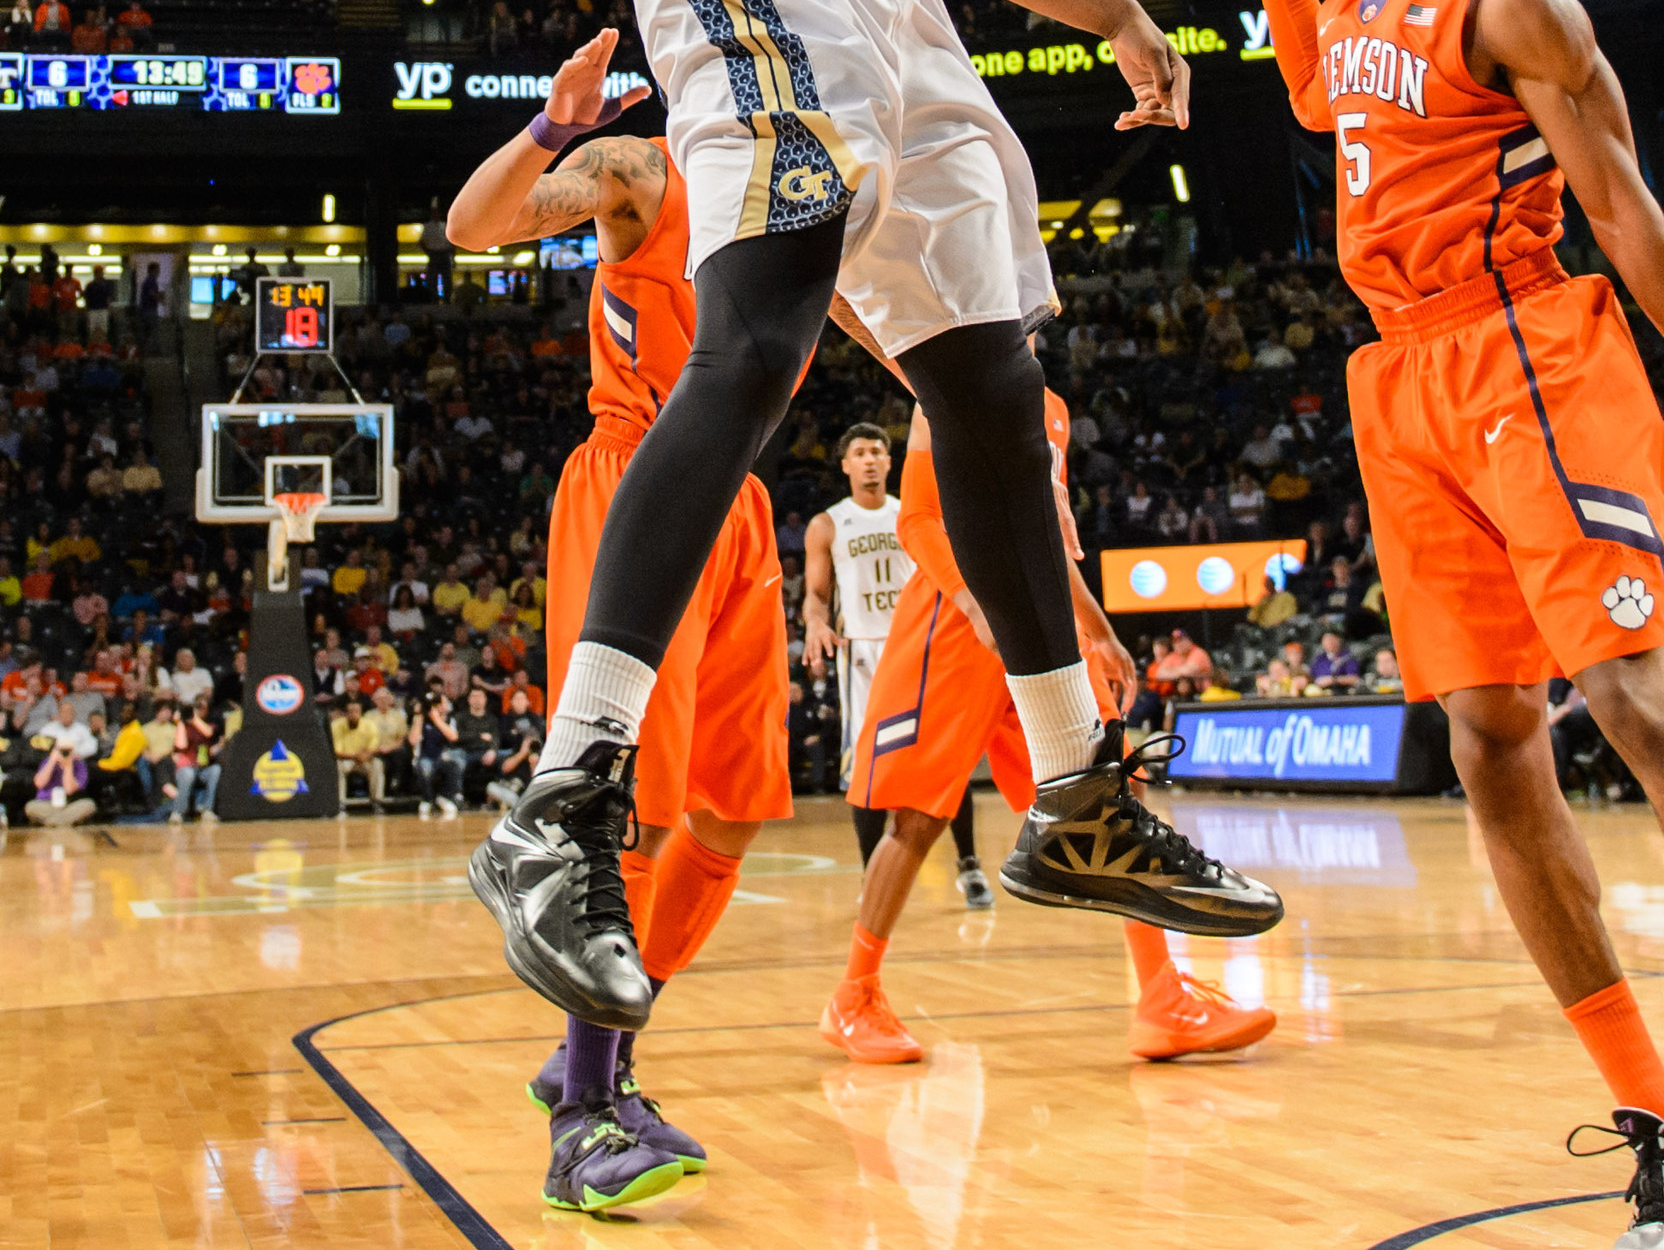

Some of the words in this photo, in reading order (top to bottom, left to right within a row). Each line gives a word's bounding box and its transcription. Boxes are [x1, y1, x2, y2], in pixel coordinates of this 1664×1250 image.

[1027, 43, 1094, 75] app,
[48, 60, 68, 87] 6
[133, 60, 204, 86] 13:49
[239, 63, 258, 90] 6
[394, 62, 452, 100] yp
[465, 74, 554, 98] conne
[1336, 112, 1371, 197] 5
[848, 532, 903, 558] GEORG
[874, 556, 891, 583] 11
[862, 589, 902, 613] TEC
[1190, 717, 1264, 765] MUTUAL
[1265, 713, 1298, 777] of
[1292, 714, 1372, 766] OMAHA
